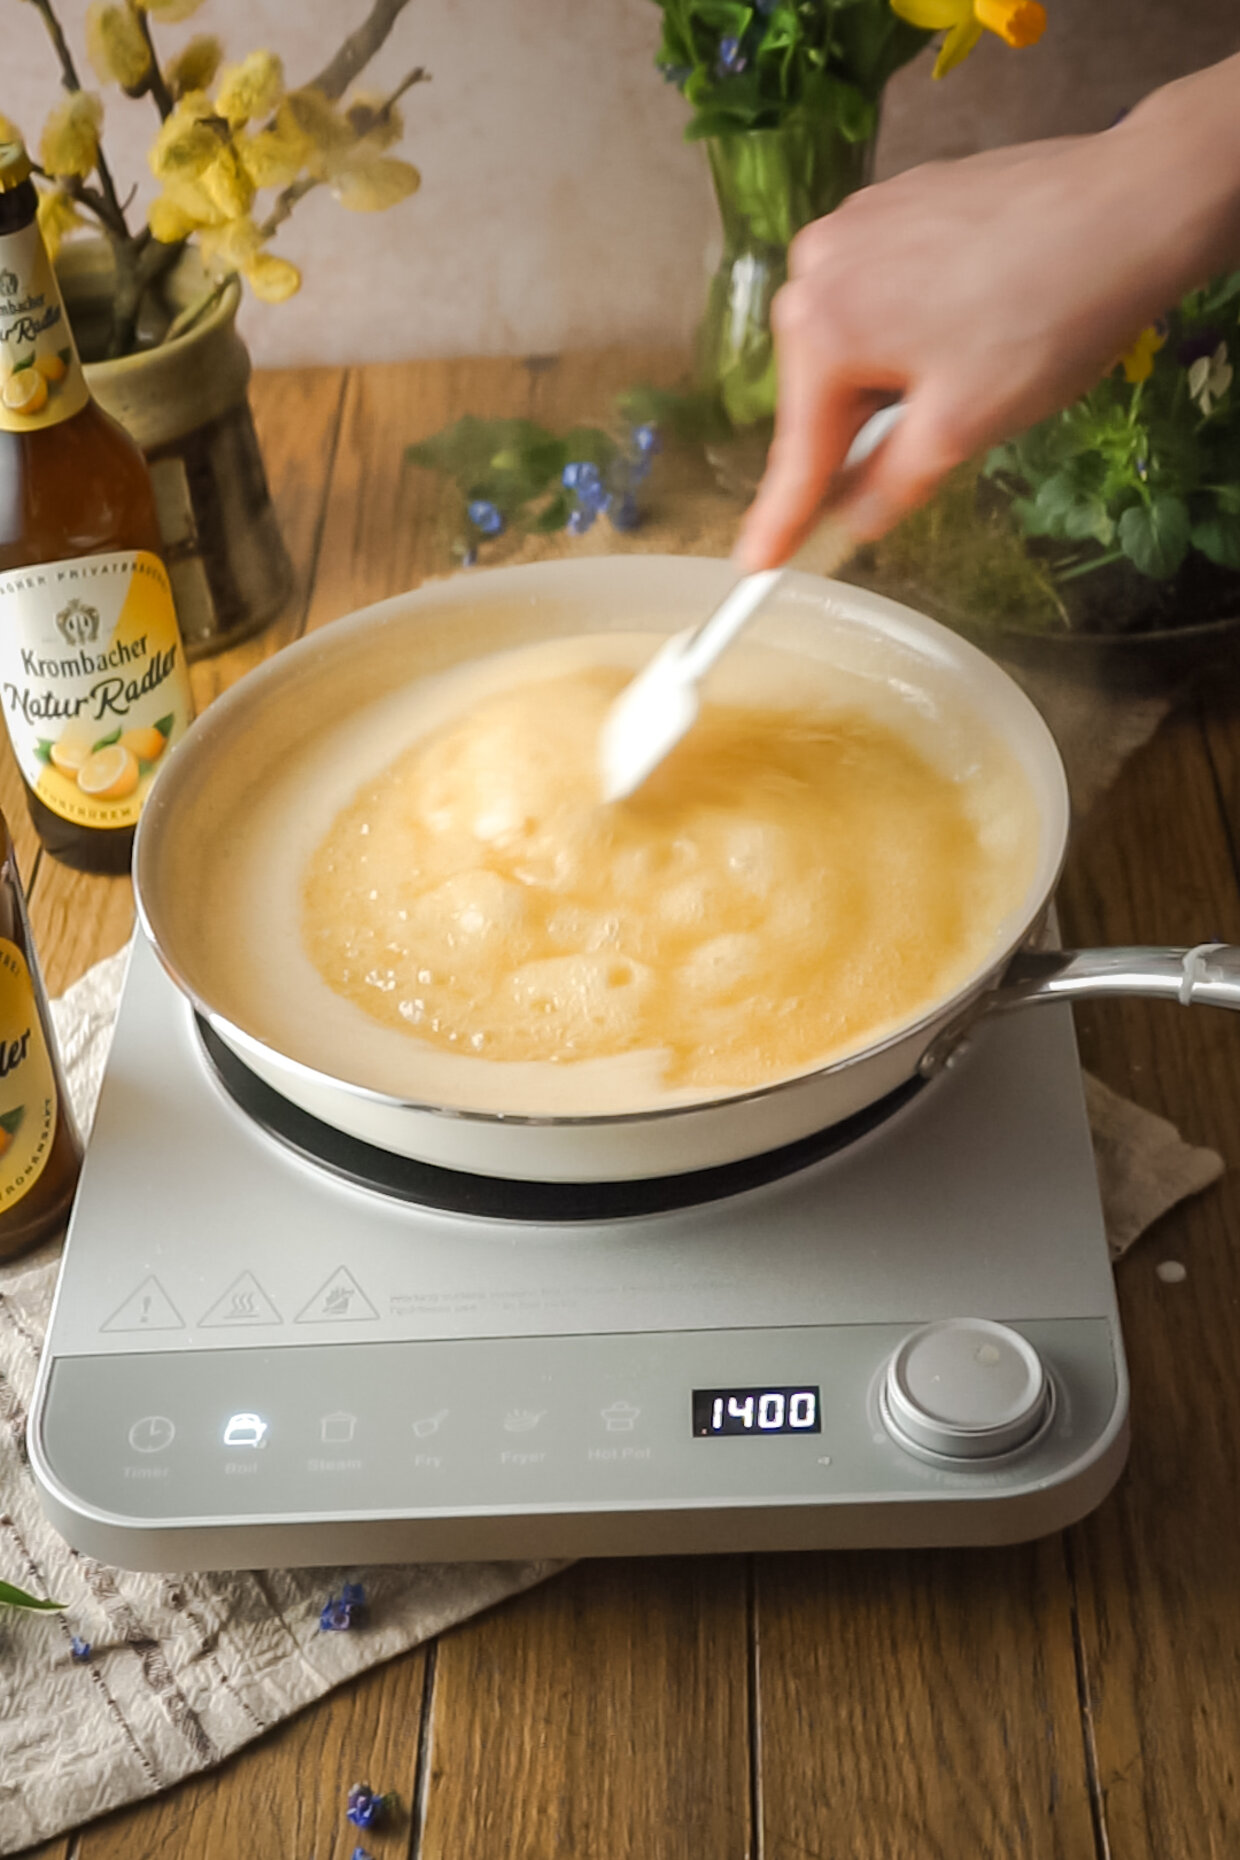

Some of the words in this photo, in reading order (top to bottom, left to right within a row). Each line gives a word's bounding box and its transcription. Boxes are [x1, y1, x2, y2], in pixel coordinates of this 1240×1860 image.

[21, 633, 148, 680] Krombacher
[3, 682, 90, 725] Natur
[90, 644, 177, 721] Radler
[711, 1393, 816, 1430] 1400
[307, 1458, 363, 1473] Steam
[414, 1453, 442, 1468] Fry
[500, 1450, 547, 1466] Fryer
[122, 1465, 170, 1480] Timer
[225, 1462, 258, 1475] Boil
